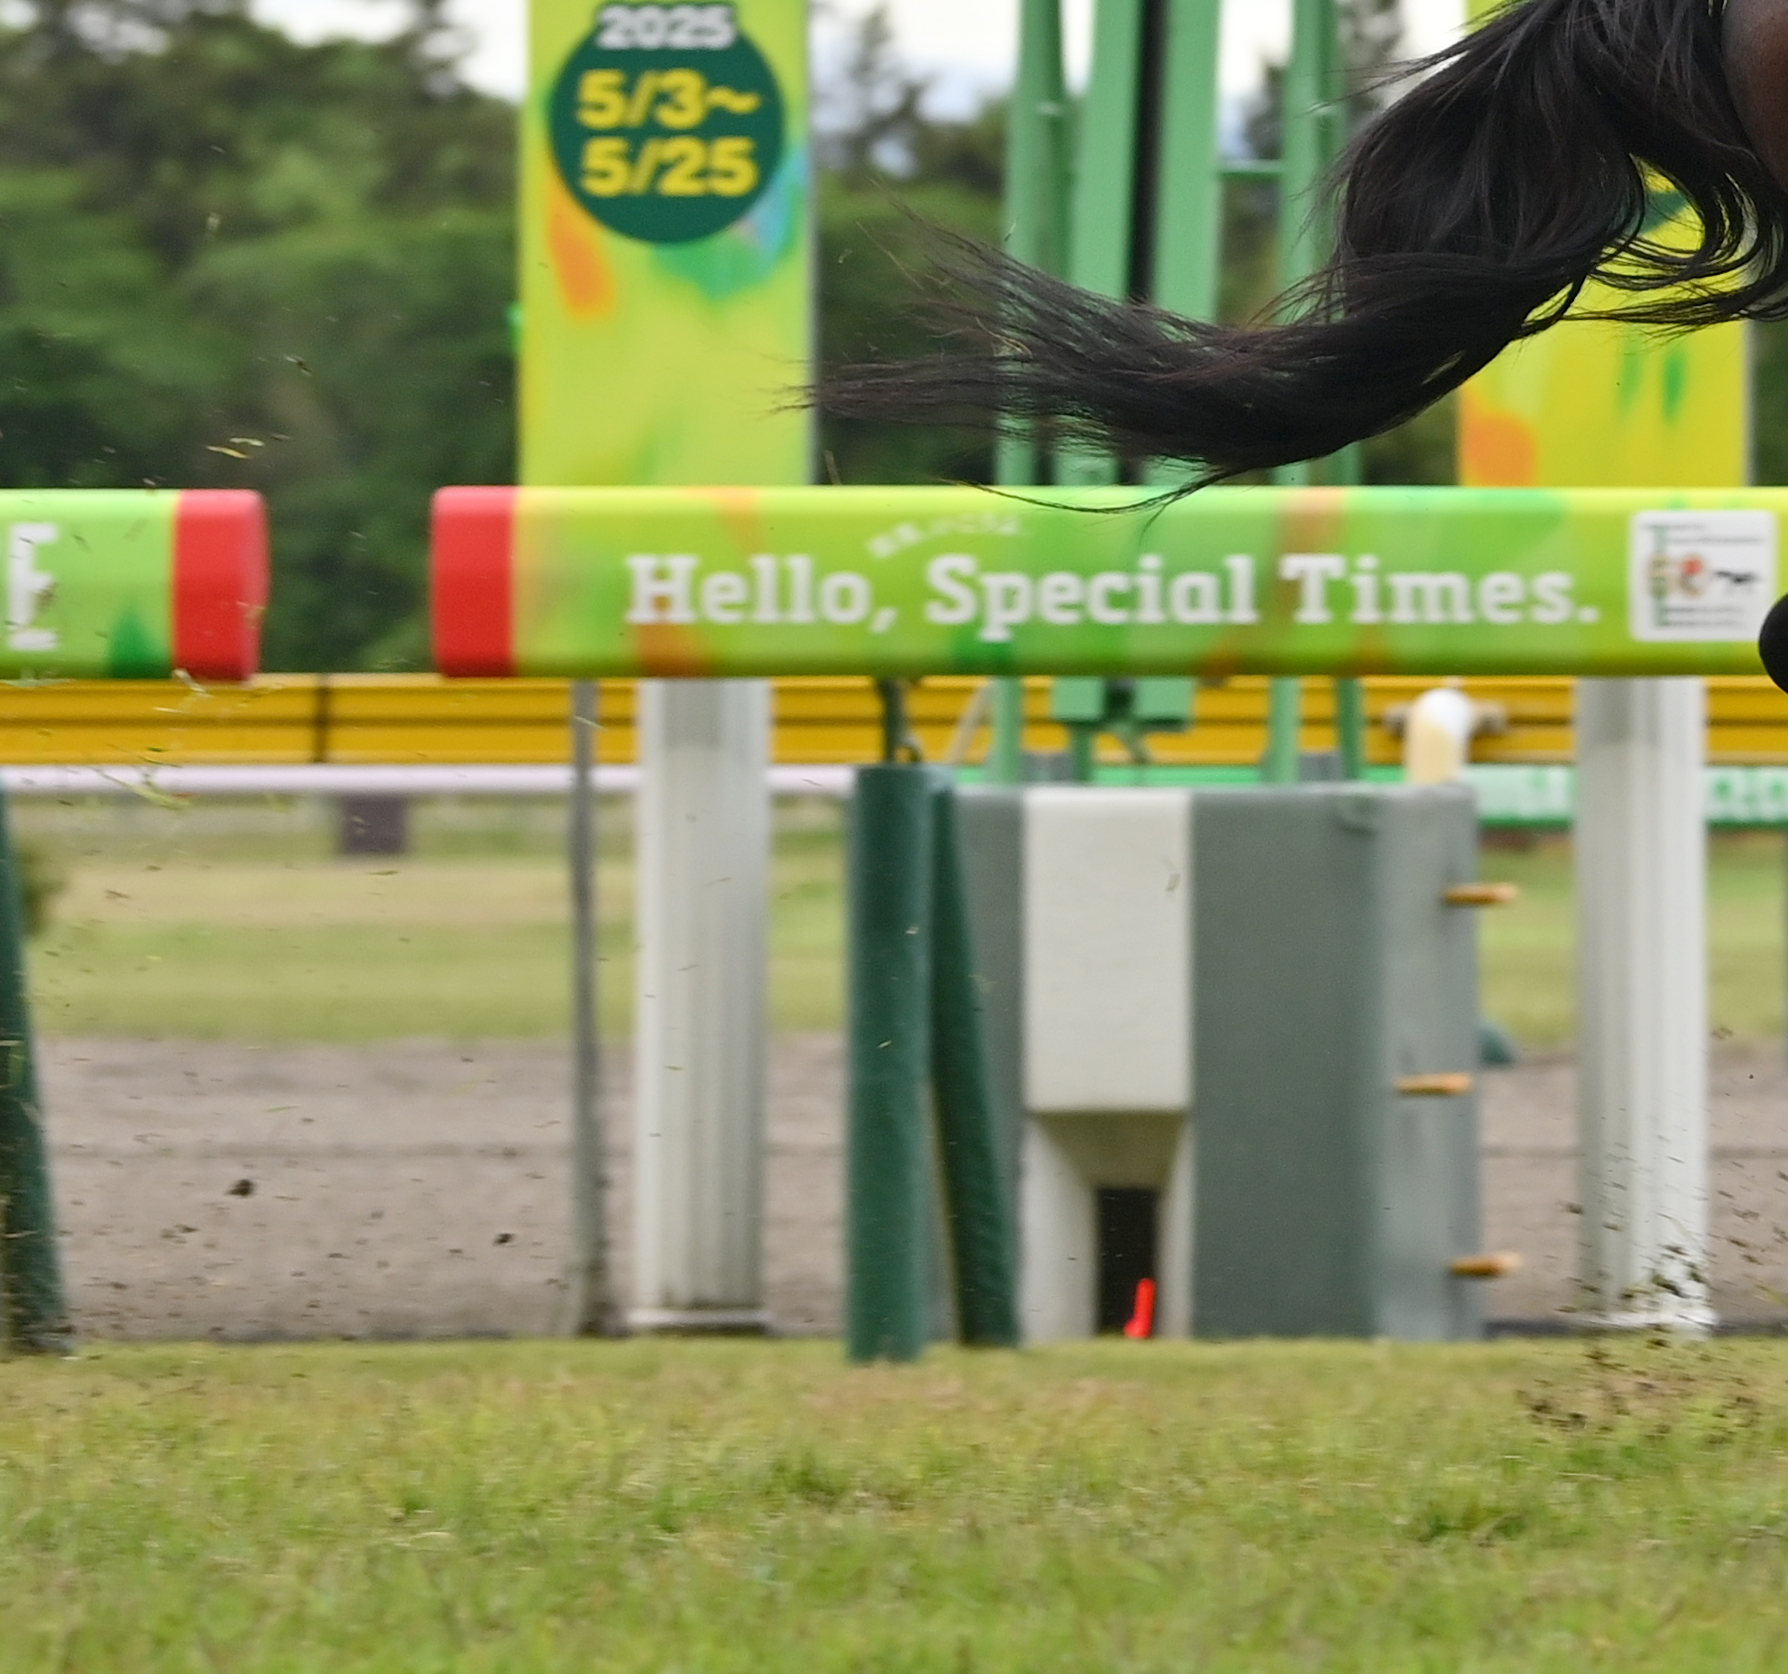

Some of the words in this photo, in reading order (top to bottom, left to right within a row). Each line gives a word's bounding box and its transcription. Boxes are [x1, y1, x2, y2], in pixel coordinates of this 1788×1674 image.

[597, 4, 738, 50] 2025
[581, 136, 758, 196] 5/25
[626, 553, 899, 634] Hello,
[926, 553, 1257, 642] Special
[1279, 554, 1599, 625] Times.
